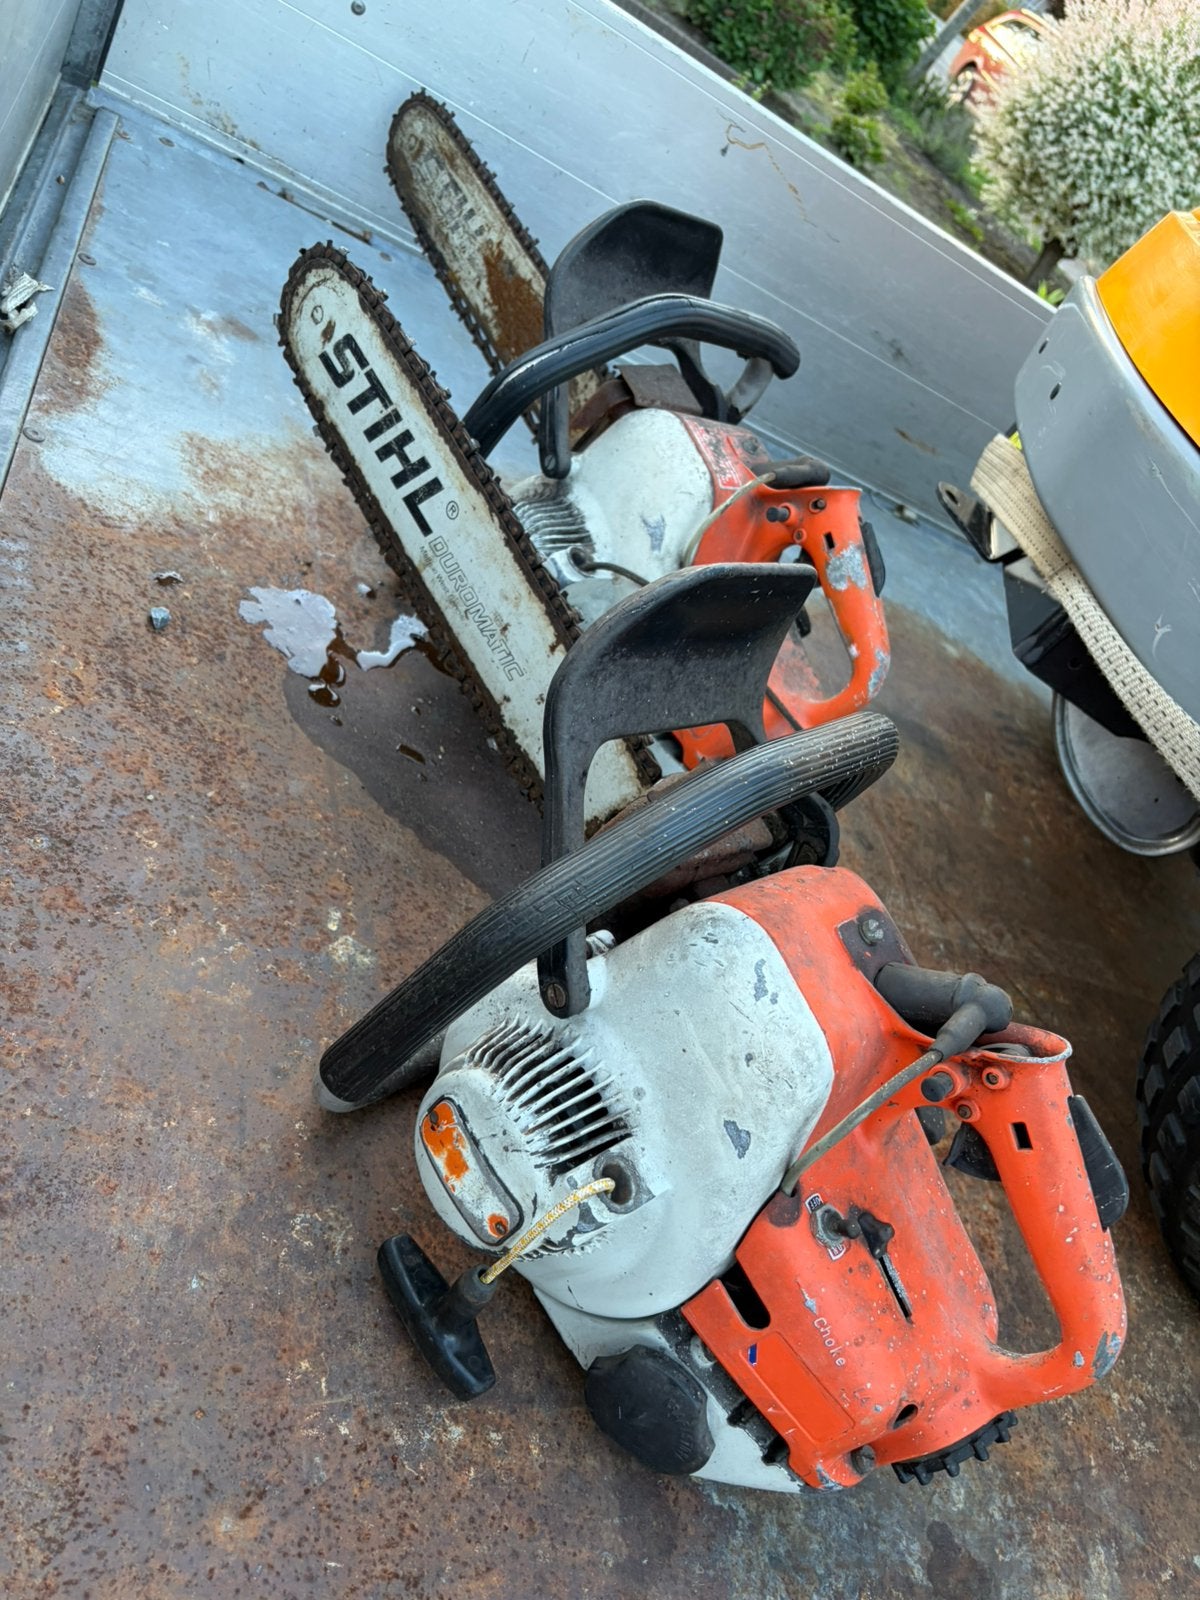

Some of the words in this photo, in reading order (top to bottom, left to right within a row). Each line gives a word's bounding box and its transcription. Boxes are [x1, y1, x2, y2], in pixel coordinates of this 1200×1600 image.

[318, 333, 445, 537] STIHL
[428, 535, 525, 682] DUROMATIC
[813, 1317, 846, 1367] Choke
